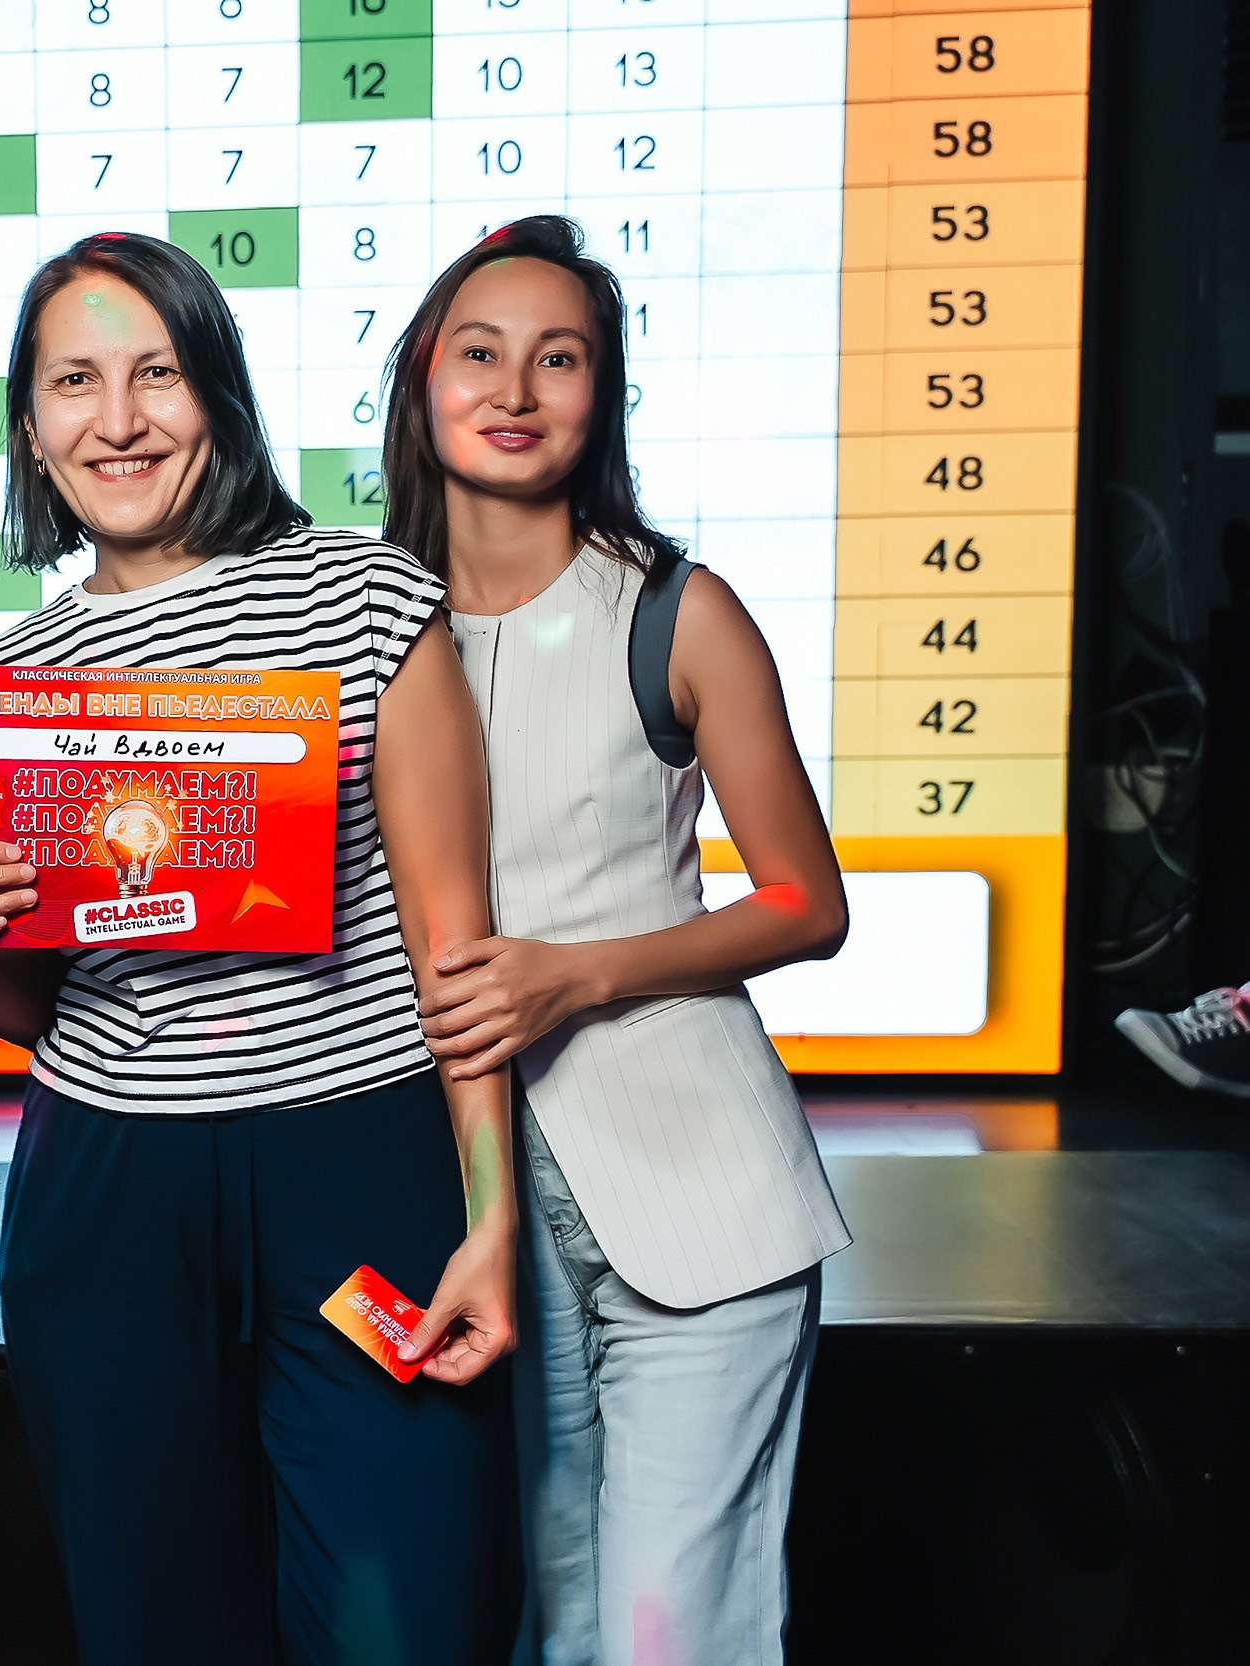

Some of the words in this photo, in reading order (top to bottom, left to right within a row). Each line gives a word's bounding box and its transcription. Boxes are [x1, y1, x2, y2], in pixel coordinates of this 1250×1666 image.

[89, 0, 109, 24] 8
[617, 52, 656, 87] 13
[936, 36, 995, 73] 58
[90, 73, 111, 107] 8
[222, 68, 242, 102] 7
[343, 62, 386, 100] 12
[479, 57, 522, 92] 10
[615, 136, 656, 170] 12
[934, 121, 992, 157] 58
[92, 155, 112, 188] 7
[223, 150, 242, 184] 7
[355, 146, 376, 179] 7
[478, 140, 521, 175] 10
[619, 220, 648, 253] 11
[933, 206, 989, 241] 53
[210, 232, 255, 268] 10
[354, 228, 376, 261] 8
[930, 291, 986, 326] 53
[354, 310, 375, 343] 7
[353, 392, 375, 424] 6
[928, 374, 984, 409] 53
[343, 472, 382, 505] 12
[926, 457, 983, 490] 48
[923, 538, 981, 572] 46
[922, 620, 977, 653] 44
[12, 670, 103, 682] КЛАССИЧЕСКАЯ
[106, 671, 229, 684] ИНТЕЛЛЕКТУАЛЬНАЯ
[231, 674, 261, 685] ИГРА
[86, 693, 141, 717] ВНЕ
[148, 693, 331, 720] ПЬЕДЕСТАЛА
[920, 700, 977, 734] 42
[54, 733, 97, 756] Чай
[12, 768, 257, 800] #ПОДУМАЕМ?!
[919, 781, 974, 815] 37
[12, 803, 256, 834] #ПОДЕМ?!
[17, 837, 255, 868] #ПОДАЕМ?!
[85, 899, 185, 924] #CLASSIC
[86, 919, 155, 935] INTELLECTUAL
[157, 916, 186, 927] GAME
[366, 1313, 379, 1325] НА
[371, 1305, 411, 1341] ПЛАТНУЮ
[378, 1322, 403, 1347] ХОДКА
